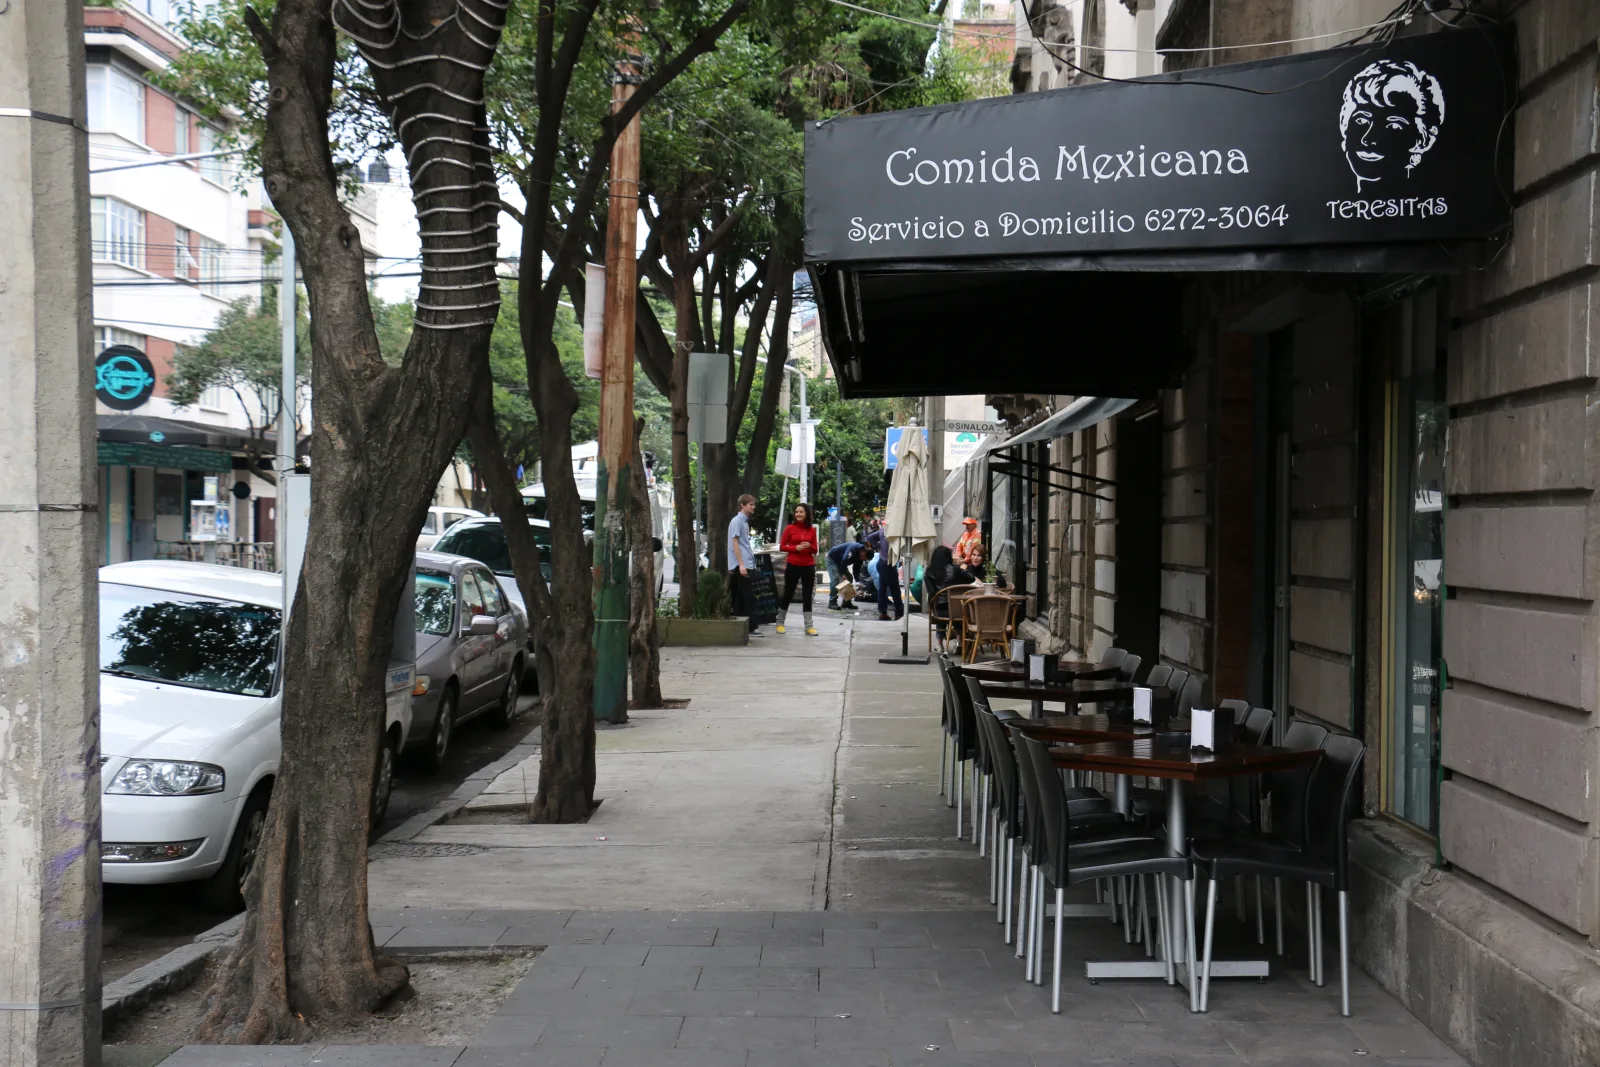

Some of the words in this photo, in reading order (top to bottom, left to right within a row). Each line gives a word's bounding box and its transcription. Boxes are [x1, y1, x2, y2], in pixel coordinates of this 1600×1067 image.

[885, 146, 1041, 186] Comida
[1054, 144, 1250, 184] Mexicana
[847, 215, 965, 244] Servicio
[974, 219, 990, 238] a
[998, 208, 1135, 237] Domicilio
[1144, 204, 1289, 232] 6272-3064
[1326, 197, 1448, 220] TERESITAS
[955, 422, 995, 432] SINALOA
